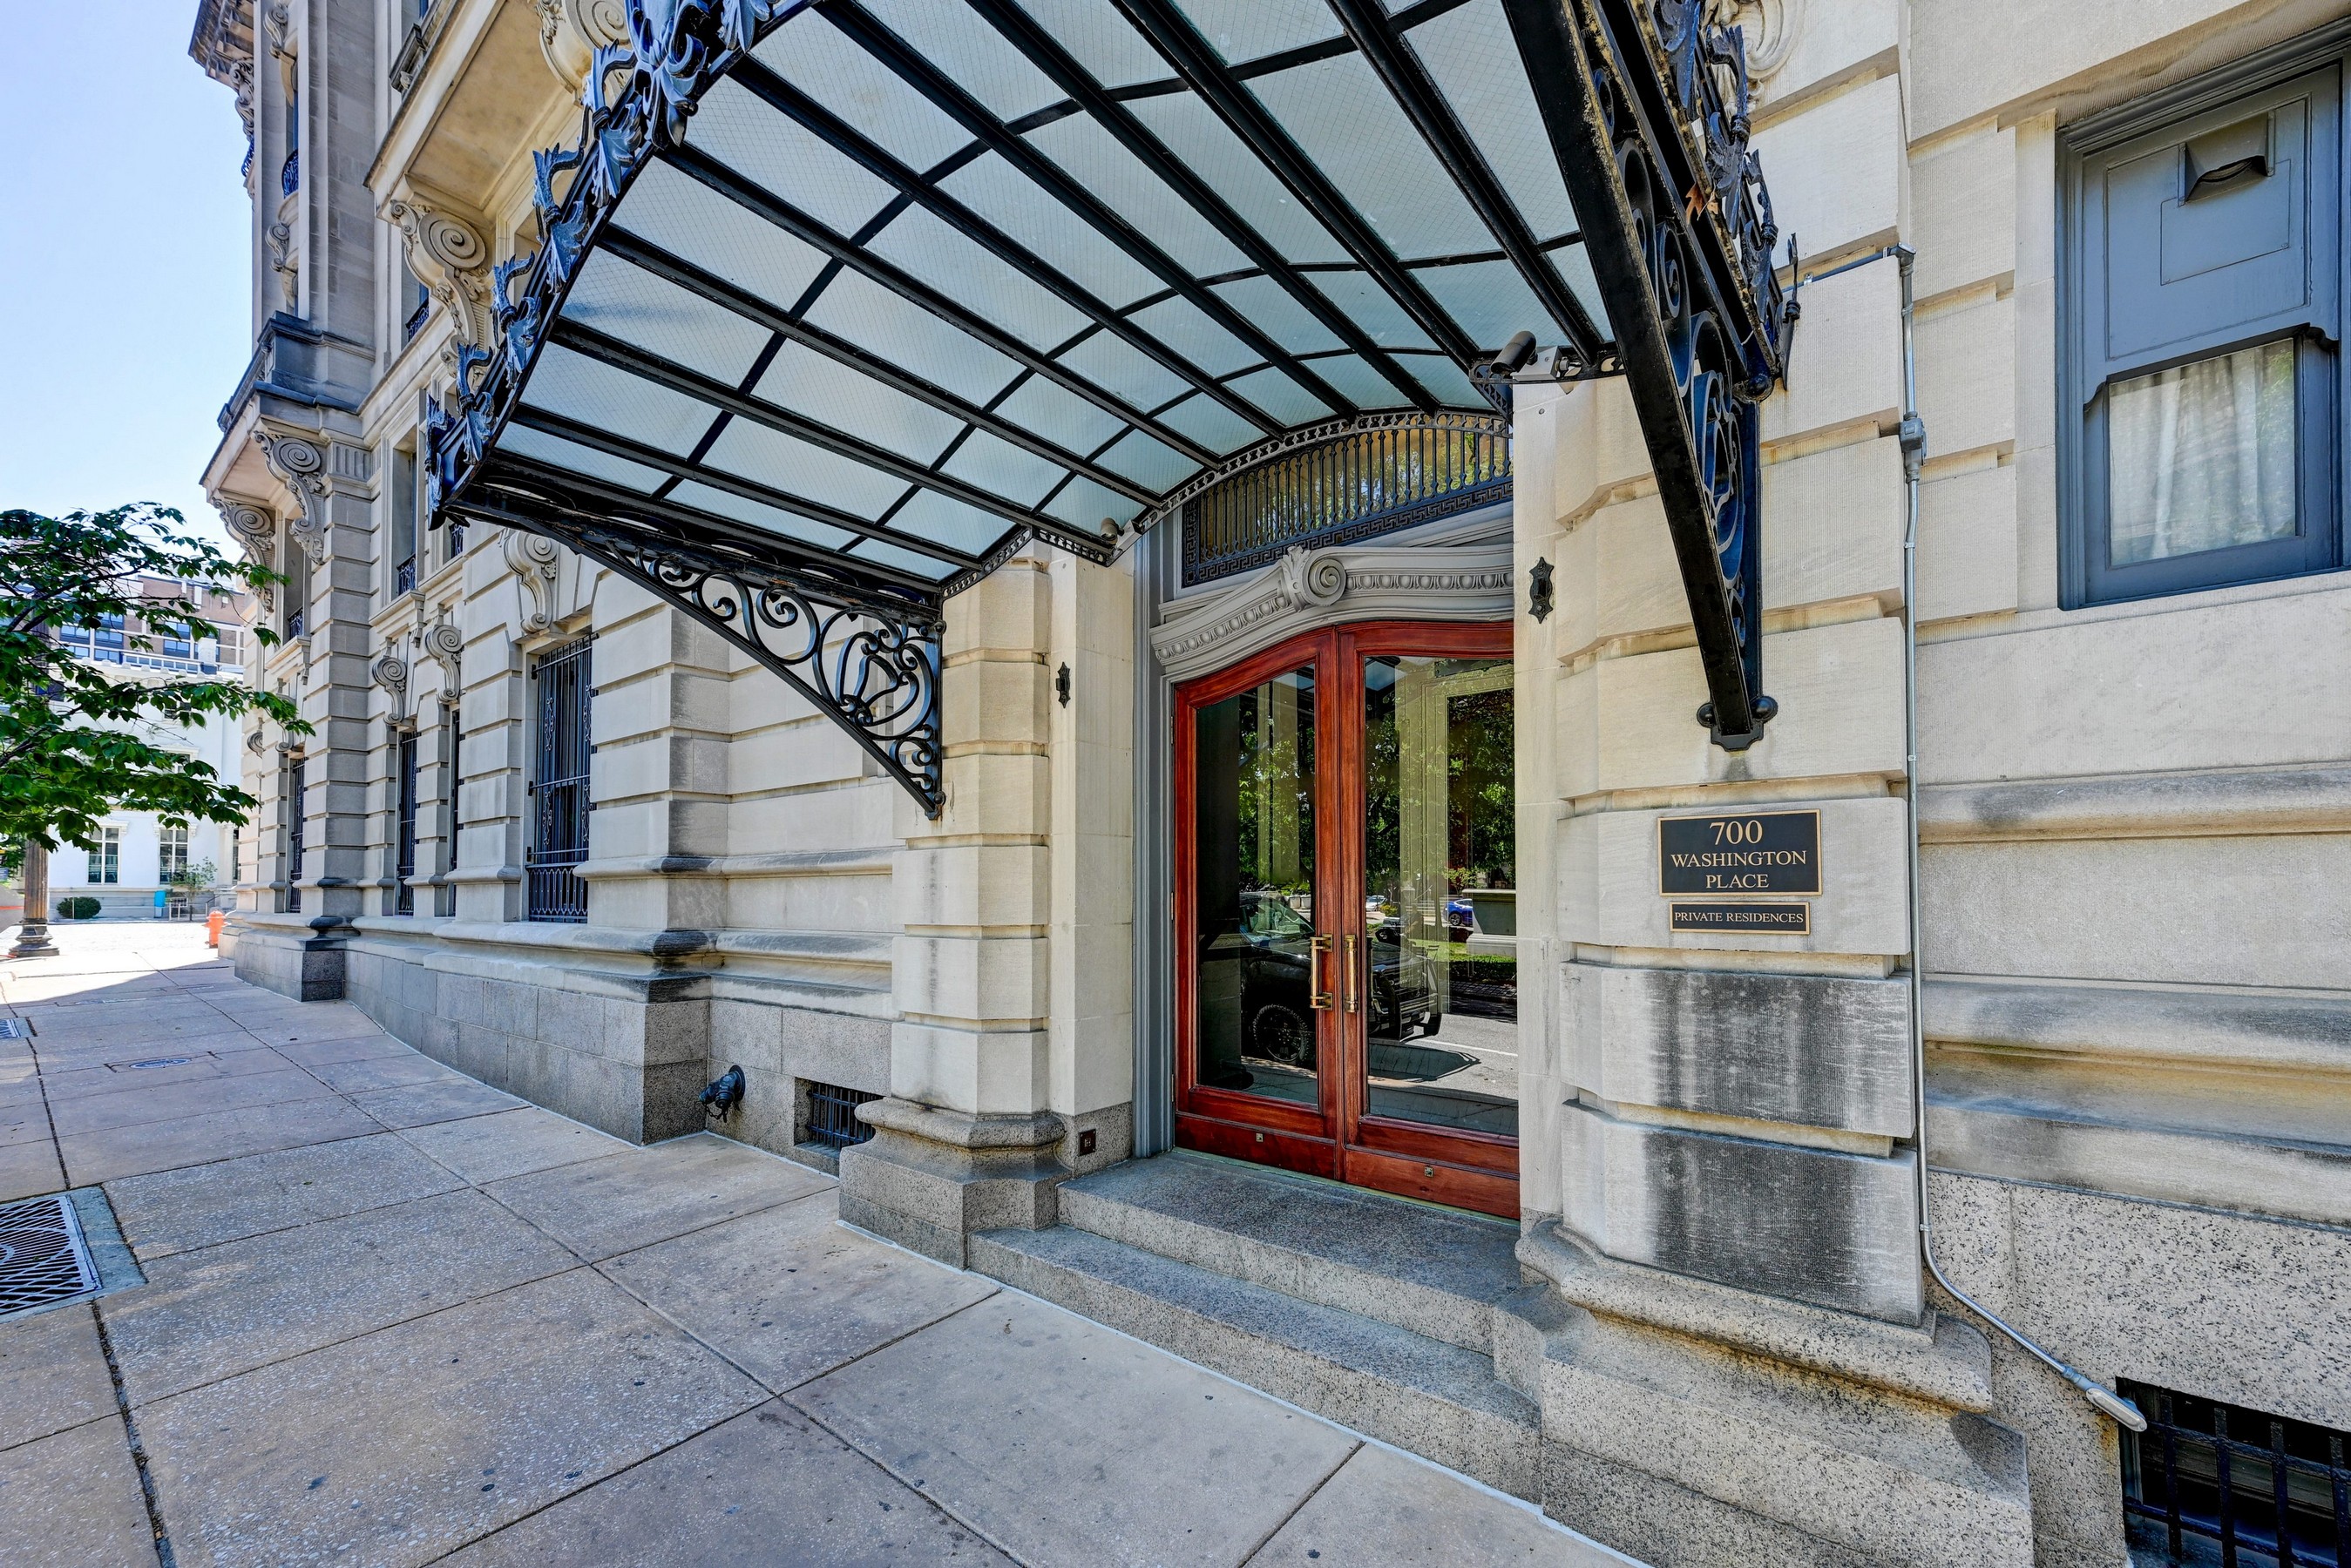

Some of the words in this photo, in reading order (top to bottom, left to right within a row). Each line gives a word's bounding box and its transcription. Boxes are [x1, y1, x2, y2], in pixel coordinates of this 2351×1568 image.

[1709, 820, 1763, 846] 700
[1670, 850, 1806, 868] WASHINGTON
[1705, 874, 1769, 889] PLACE
[1674, 912, 1723, 922] PRIVATE
[1726, 912, 1804, 923] RESIDENCES
